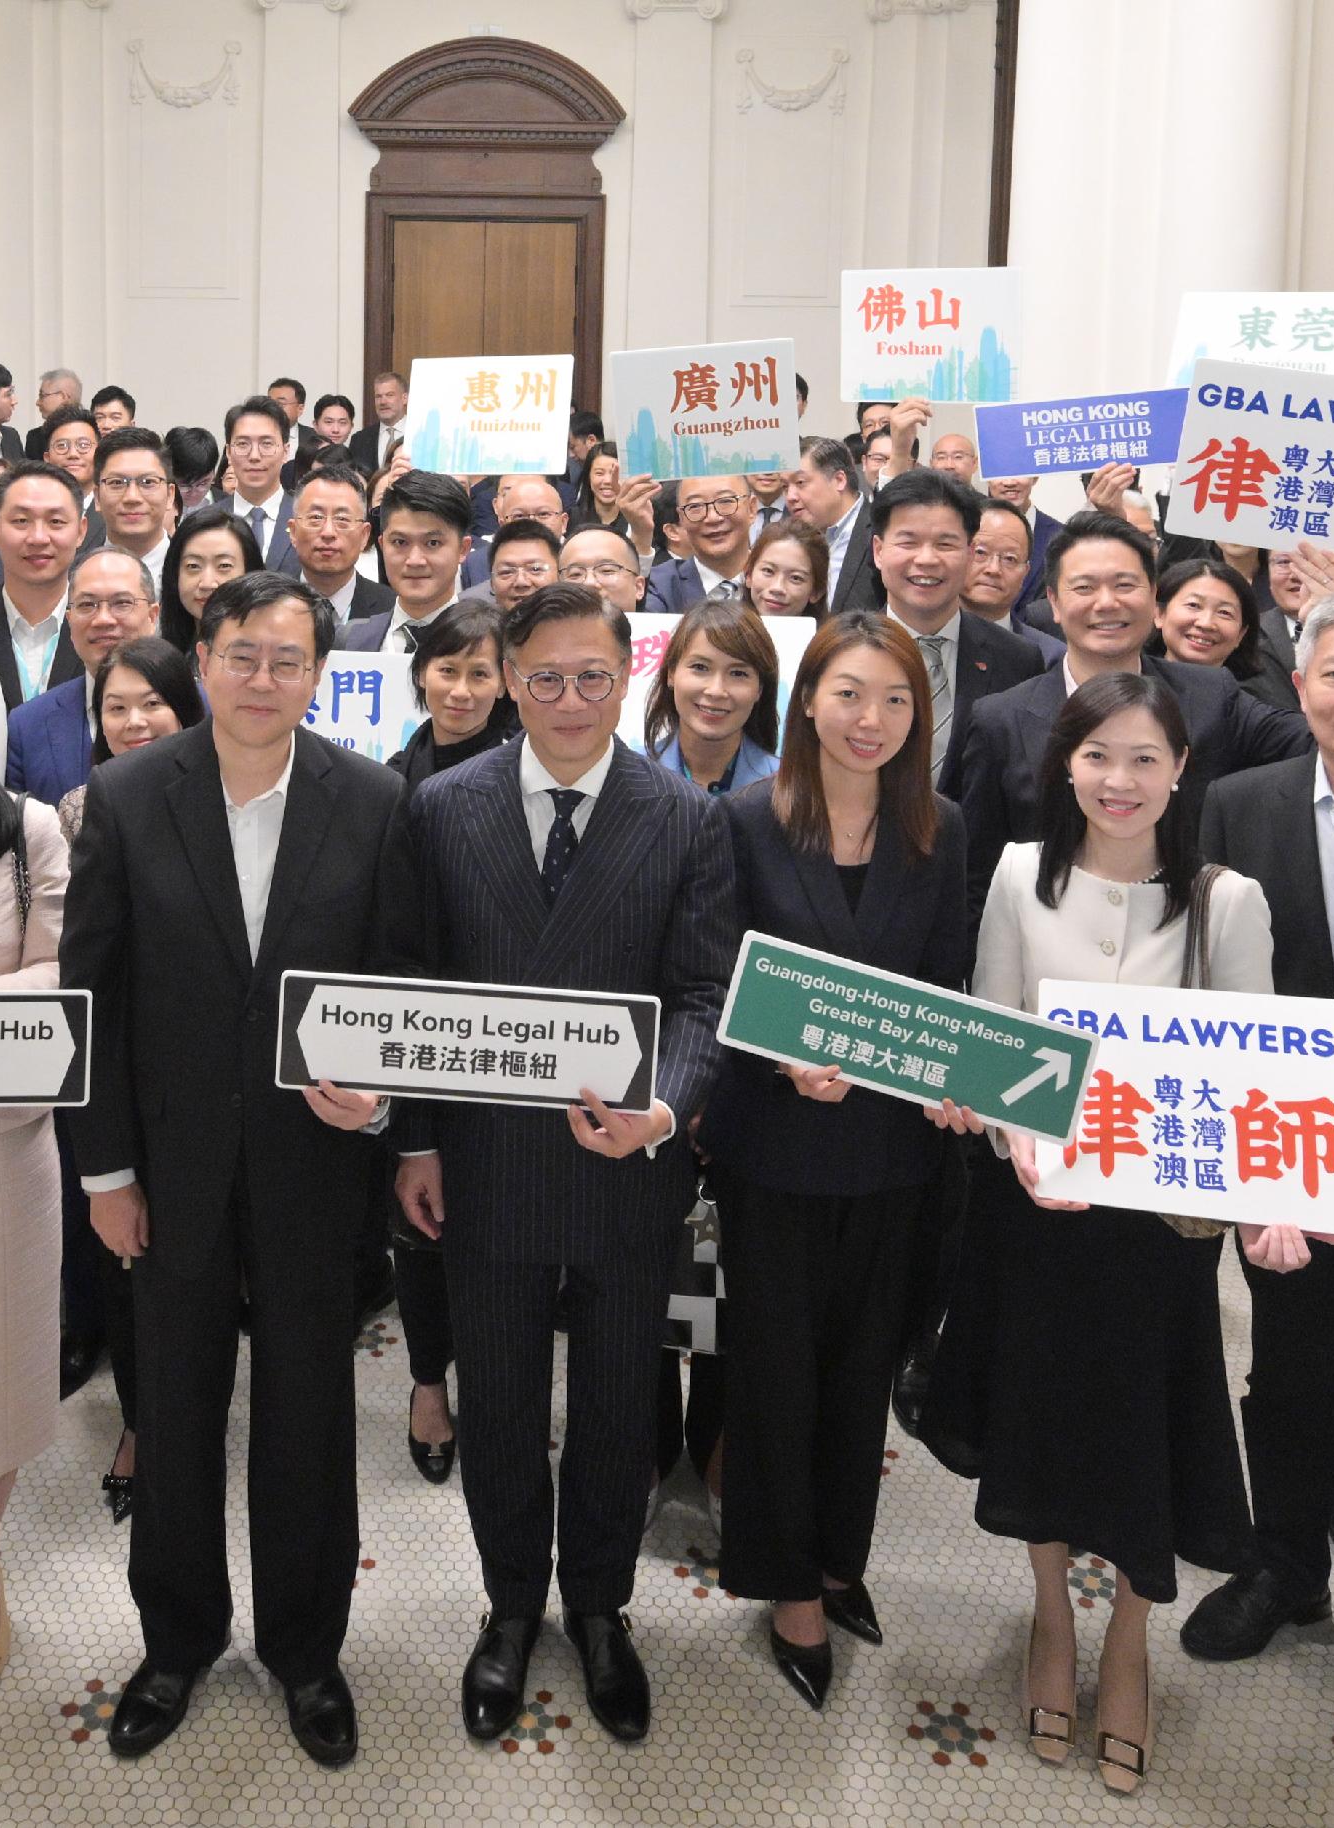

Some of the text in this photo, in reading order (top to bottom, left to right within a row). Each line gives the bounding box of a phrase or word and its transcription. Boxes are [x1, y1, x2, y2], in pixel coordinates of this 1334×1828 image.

[856, 284, 961, 334] 佛山
[876, 341, 943, 356] Foshan
[461, 368, 558, 413] 惠州
[669, 356, 779, 415] 廣州
[1198, 383, 1269, 415] GBA
[470, 419, 543, 433] Huizhou
[673, 415, 780, 438] Guangzhou
[1022, 401, 1150, 427] HONG KONG
[1025, 421, 1152, 447] LEGAL HUB
[1033, 440, 1149, 467] 香港法律樞紐
[755, 957, 1026, 1050] Guangdong-Hong Kong-Macao
[0, 1020, 54, 1041] Hub
[321, 1004, 620, 1045] Hong Kong Legal Hub
[809, 998, 959, 1055] Greater Bay Area
[379, 1041, 557, 1080] 香港法律樞紐
[800, 1023, 950, 1089] 粵港澳大灣區
